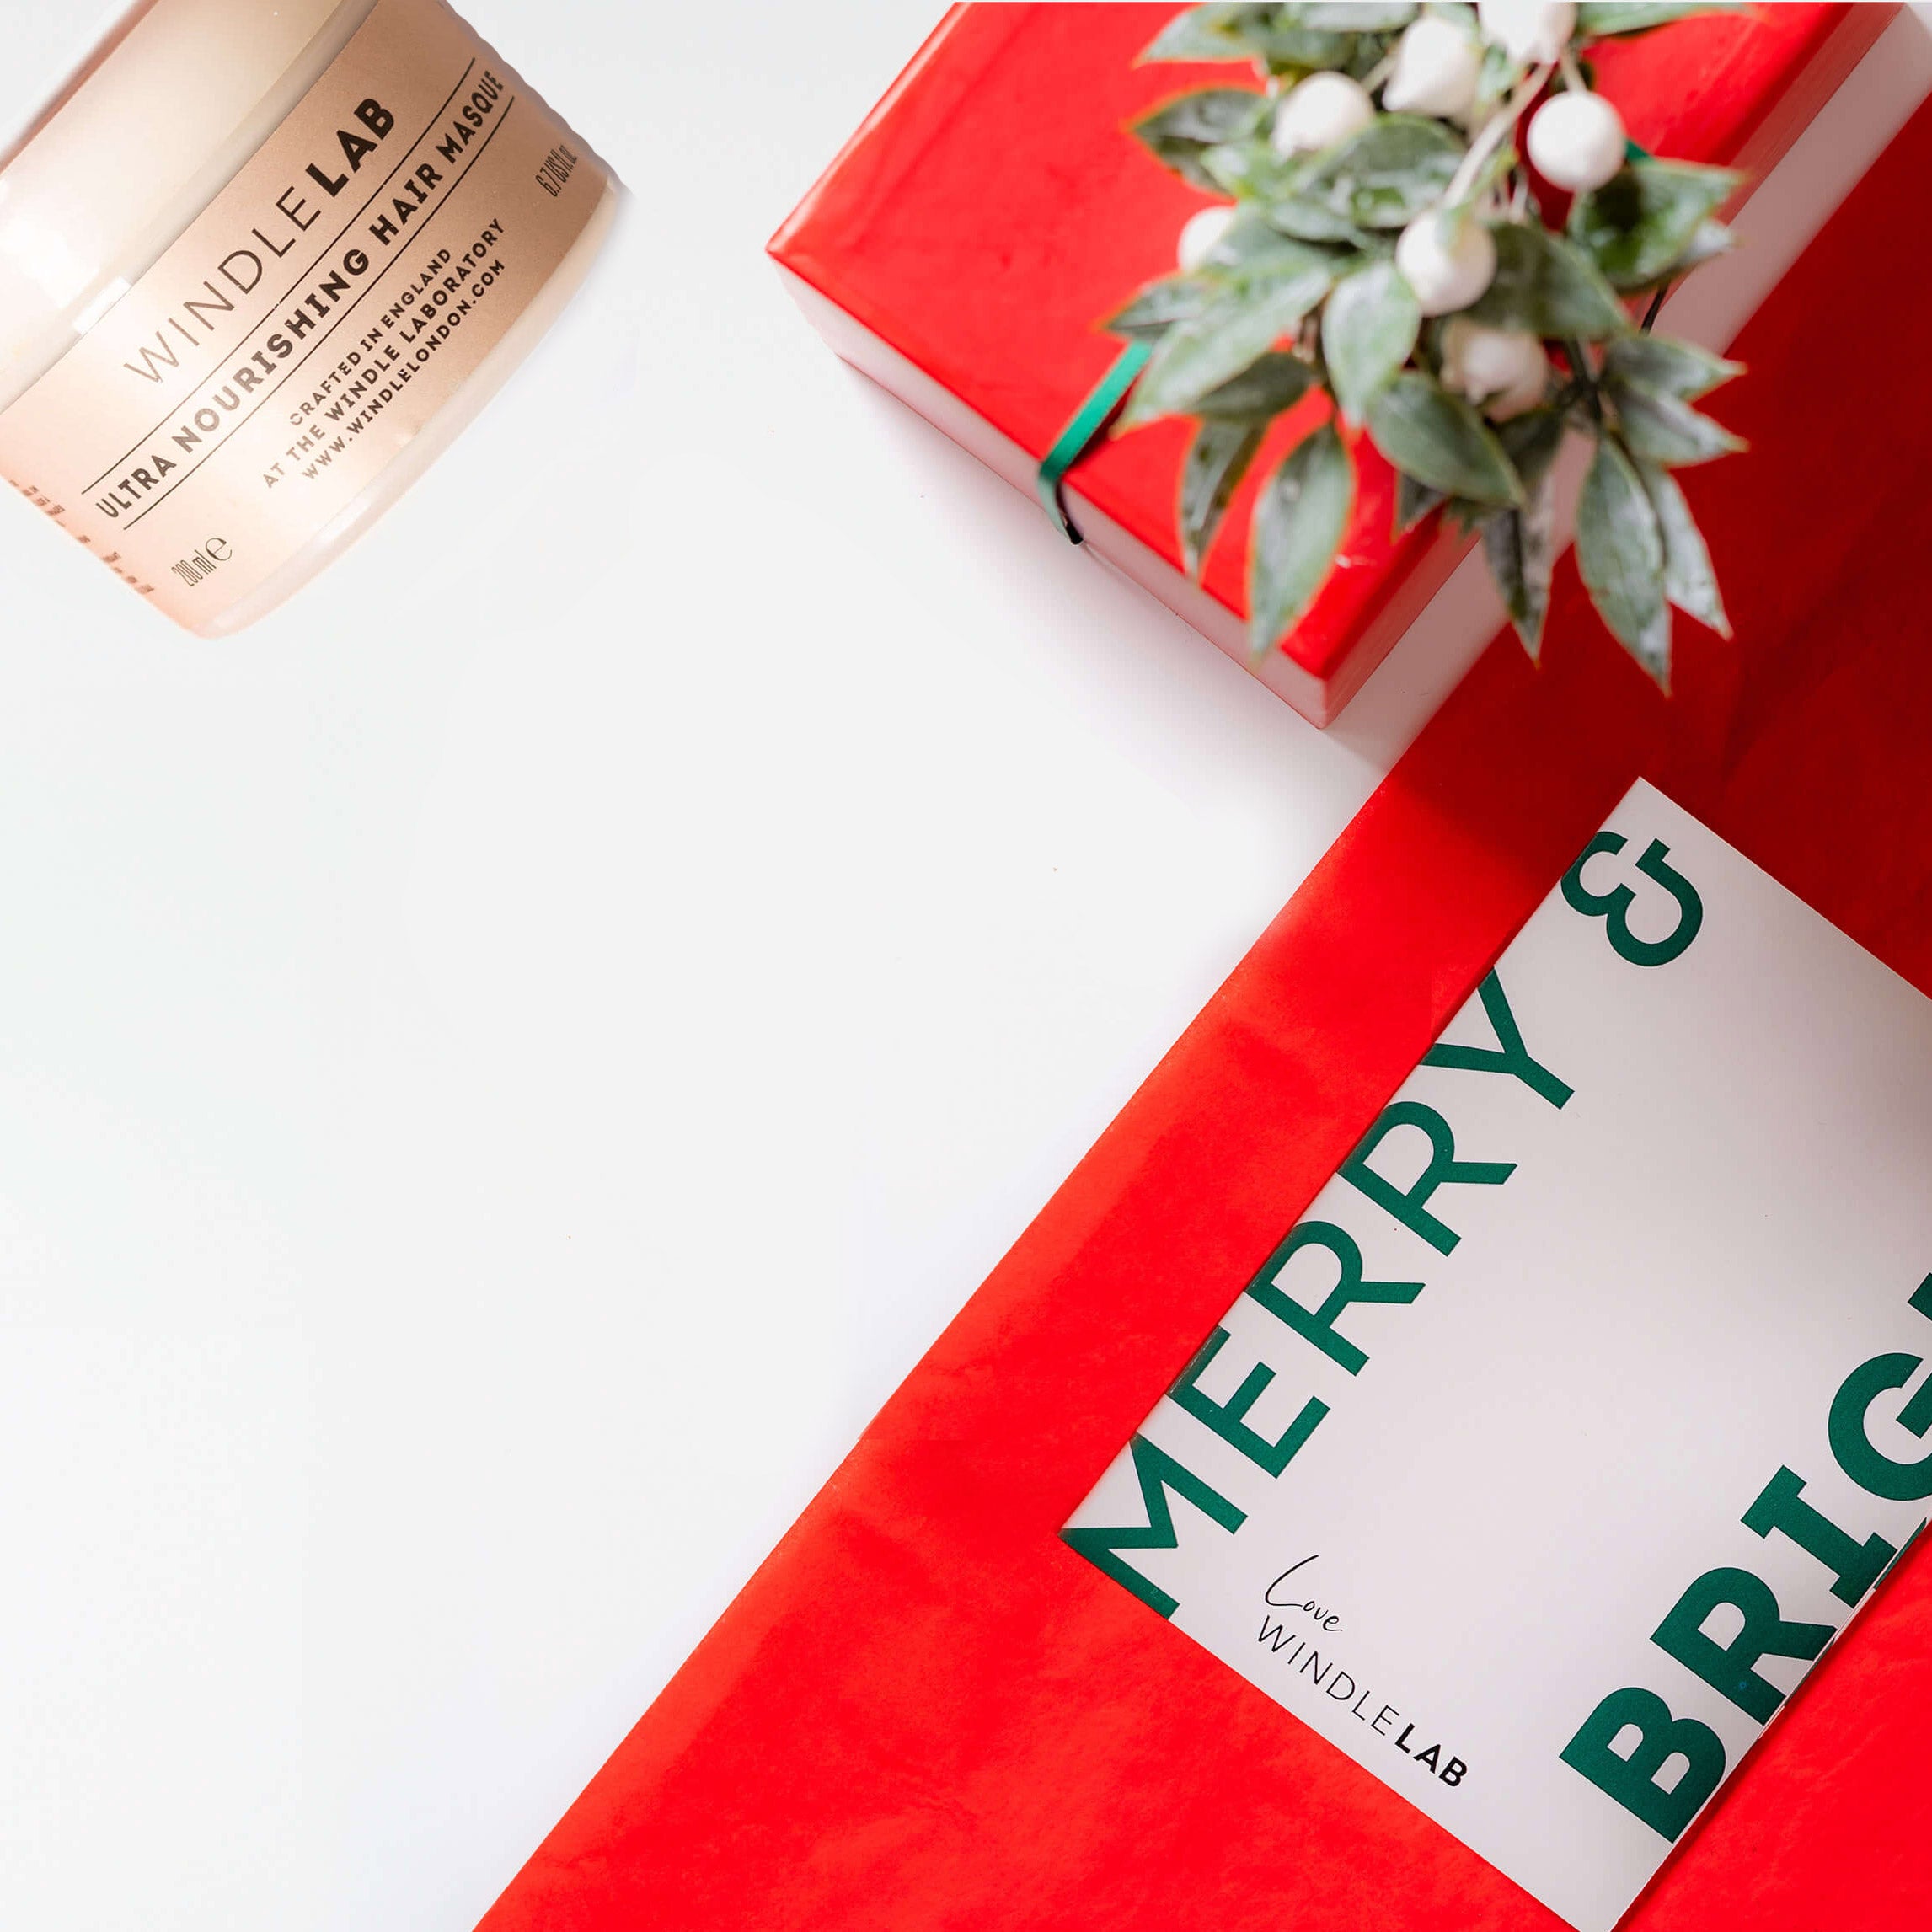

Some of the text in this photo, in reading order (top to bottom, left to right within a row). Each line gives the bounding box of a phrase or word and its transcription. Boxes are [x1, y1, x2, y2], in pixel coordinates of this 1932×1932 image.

[535, 167, 561, 197] 6.7
[543, 156, 569, 183] US
[95, 70, 504, 518] ULTRA NOURISHING HAIR MASQUE
[261, 217, 504, 489] AT THE WINDLE LABORATORY
[289, 249, 451, 426] CRAFTED IN ENGLAND
[301, 259, 505, 480] WWW.WINDLELONDON.COM
[171, 559, 203, 587] 200
[192, 549, 217, 575] ml
[1057, 831, 1704, 1620] MERRY &
[1265, 1554, 1343, 1632] Love
[1559, 1271, 1932, 1844] BRIG
